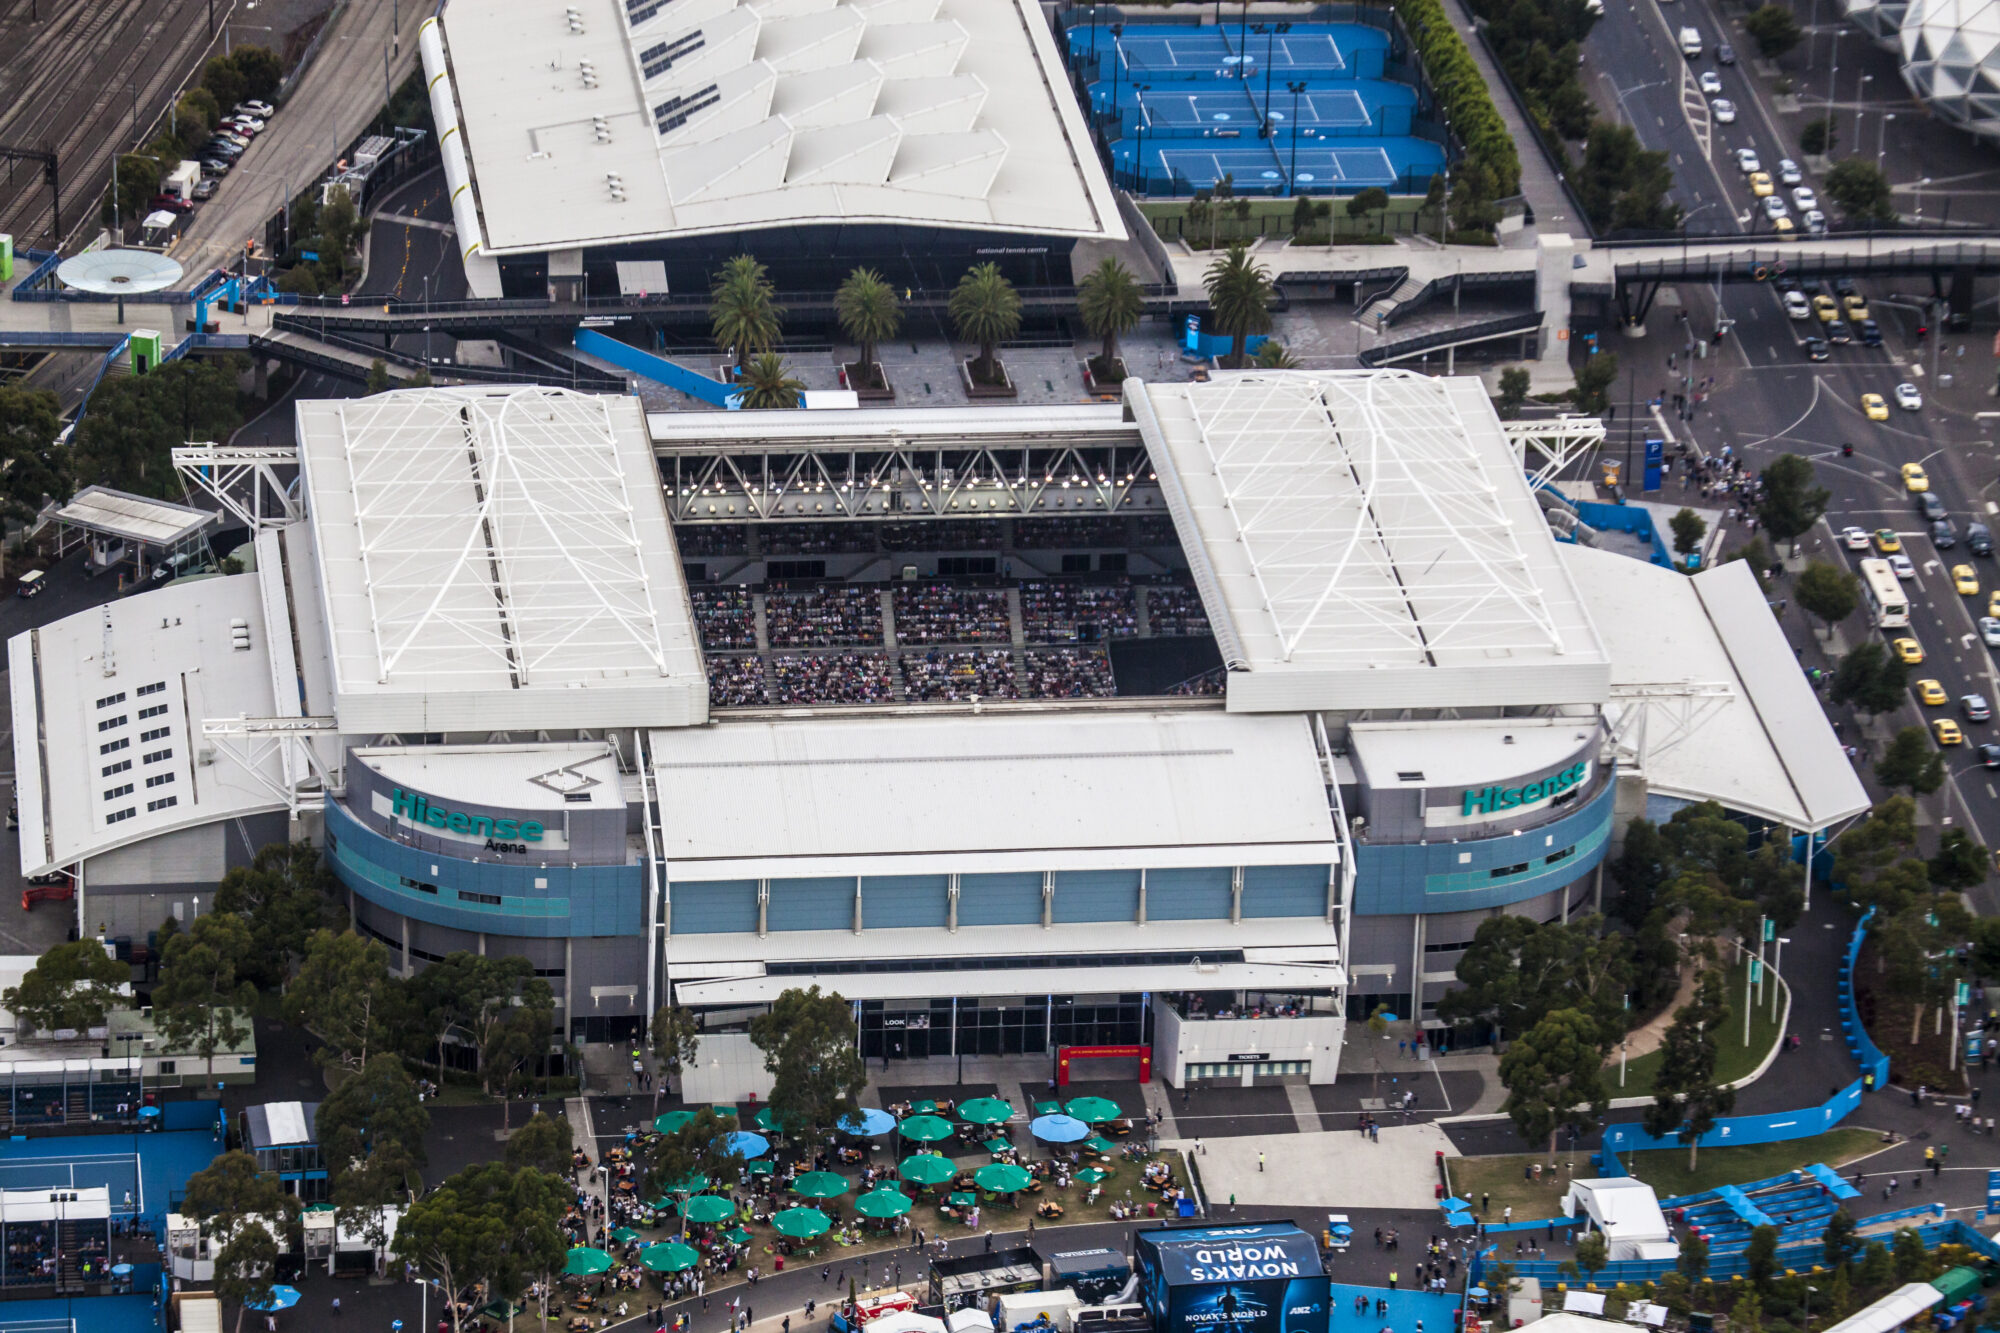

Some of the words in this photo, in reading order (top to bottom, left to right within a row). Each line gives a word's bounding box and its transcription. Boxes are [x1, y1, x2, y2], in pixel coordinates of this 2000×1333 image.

[1651, 444, 1660, 453] P
[1462, 761, 1587, 817] Hisense
[393, 788, 544, 842] Hisense
[484, 838, 527, 855] Arena
[1196, 1245, 1288, 1263] WORLD
[1190, 1262, 1300, 1281] NOVAK'S
[1185, 1312, 1228, 1322] NOVAK'S
[1231, 1309, 1268, 1319] WORLD
[1289, 1306, 1312, 1315] ANZ
